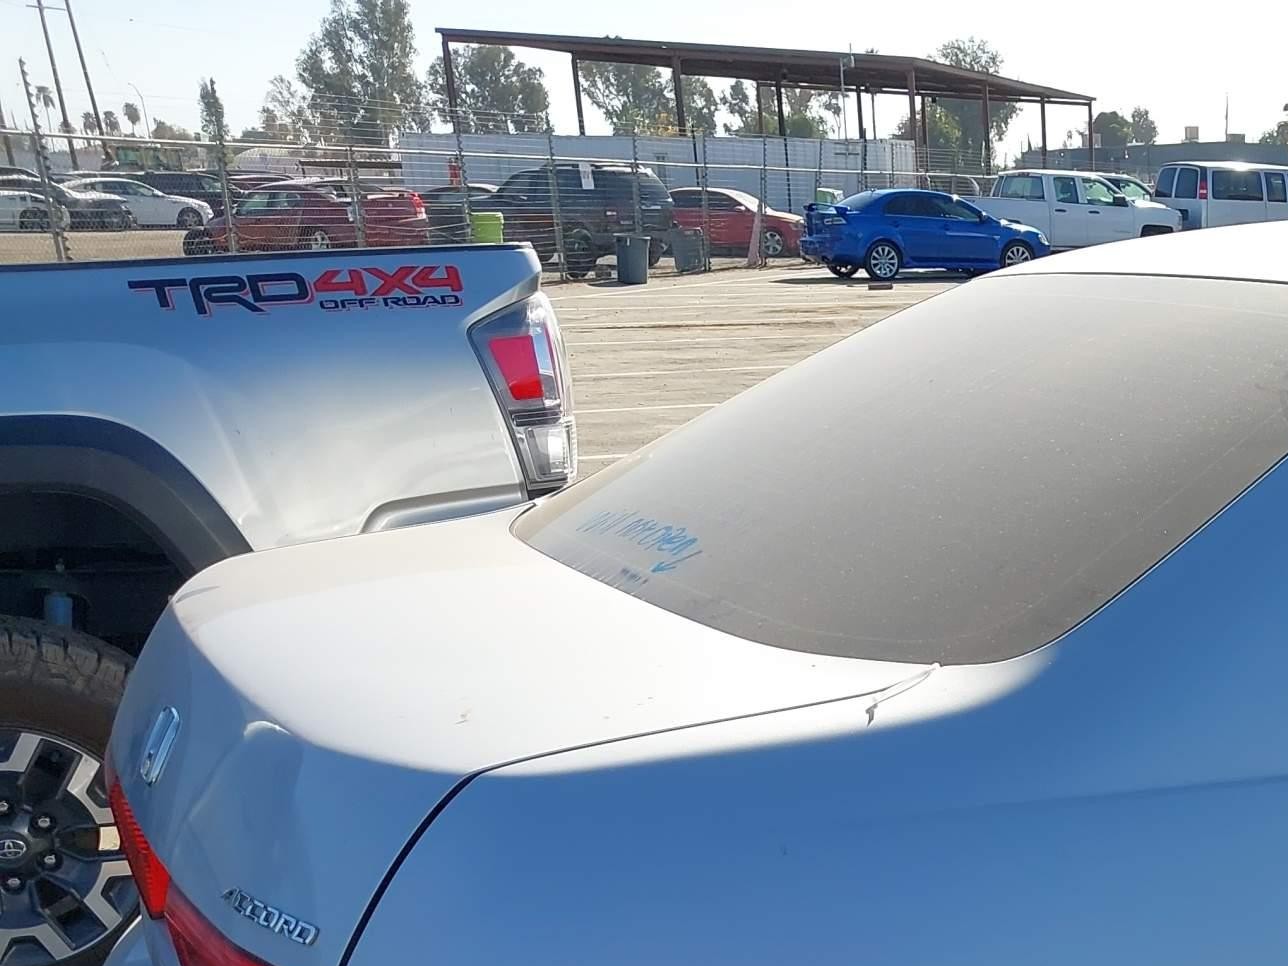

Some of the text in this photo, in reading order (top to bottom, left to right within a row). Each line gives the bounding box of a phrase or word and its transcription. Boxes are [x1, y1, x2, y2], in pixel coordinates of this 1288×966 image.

[127, 271, 314, 317] TRD
[319, 293, 463, 312] OFF ROAD
[221, 886, 320, 945] ACCORD
